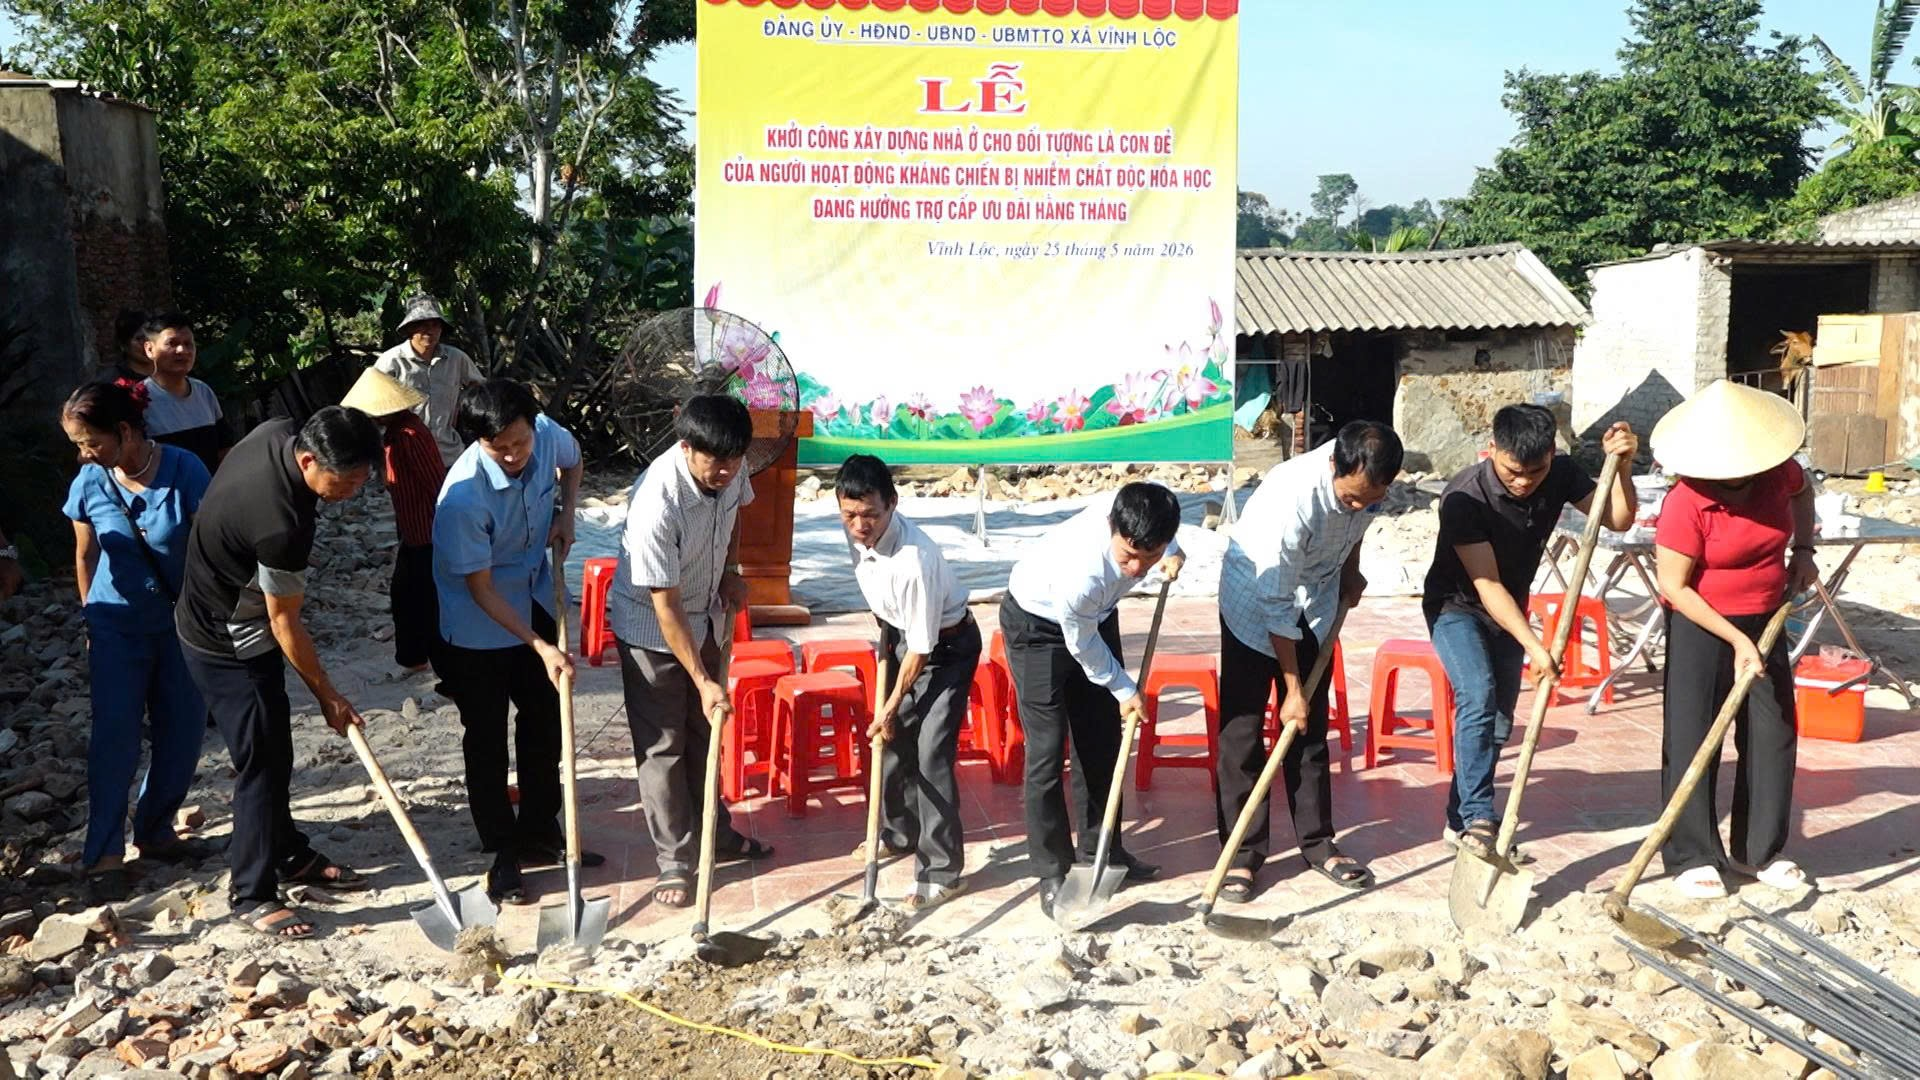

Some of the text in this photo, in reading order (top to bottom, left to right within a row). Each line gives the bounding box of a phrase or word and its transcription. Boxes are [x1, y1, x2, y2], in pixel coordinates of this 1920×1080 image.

[764, 15, 814, 36] ĐẢNG
[821, 16, 844, 38] ỦY
[861, 23, 911, 40] HĐND
[928, 25, 976, 41] UBND
[993, 27, 1064, 44] UBMTTQ
[1071, 26, 1092, 44] XÃ
[1098, 26, 1137, 45] VĨNH
[1143, 28, 1176, 49] LỘC
[920, 64, 1027, 113] LỄ
[767, 121, 1172, 157] KHỞI CÔNG XÂY DỰNG NHÀ Ở CHO ĐỐI TƯỢNG LÀ CON ĐẺ
[725, 157, 1211, 192] CỦA NGƯỜI HOẠT ĐỘNG KHÁNG CHIẾN BỊ NHIỄM CHẤT ĐỘC HÓA HỌC
[814, 199, 854, 218] ĐANG
[860, 194, 910, 219] HƯỞNG
[916, 200, 943, 224] TRỢ
[948, 194, 977, 219] CẤP
[983, 200, 1002, 220] ƯU
[1007, 197, 1030, 220] ĐÃI
[1080, 198, 1127, 221] THÁNG
[928, 241, 963, 256] Vĩnh
[969, 242, 1000, 260] Lộc,
[1005, 243, 1039, 260] ngày
[1044, 243, 1060, 257] 25
[1064, 243, 1106, 260] tháng
[1110, 243, 1119, 257] 5
[1160, 243, 1194, 257] 2026
